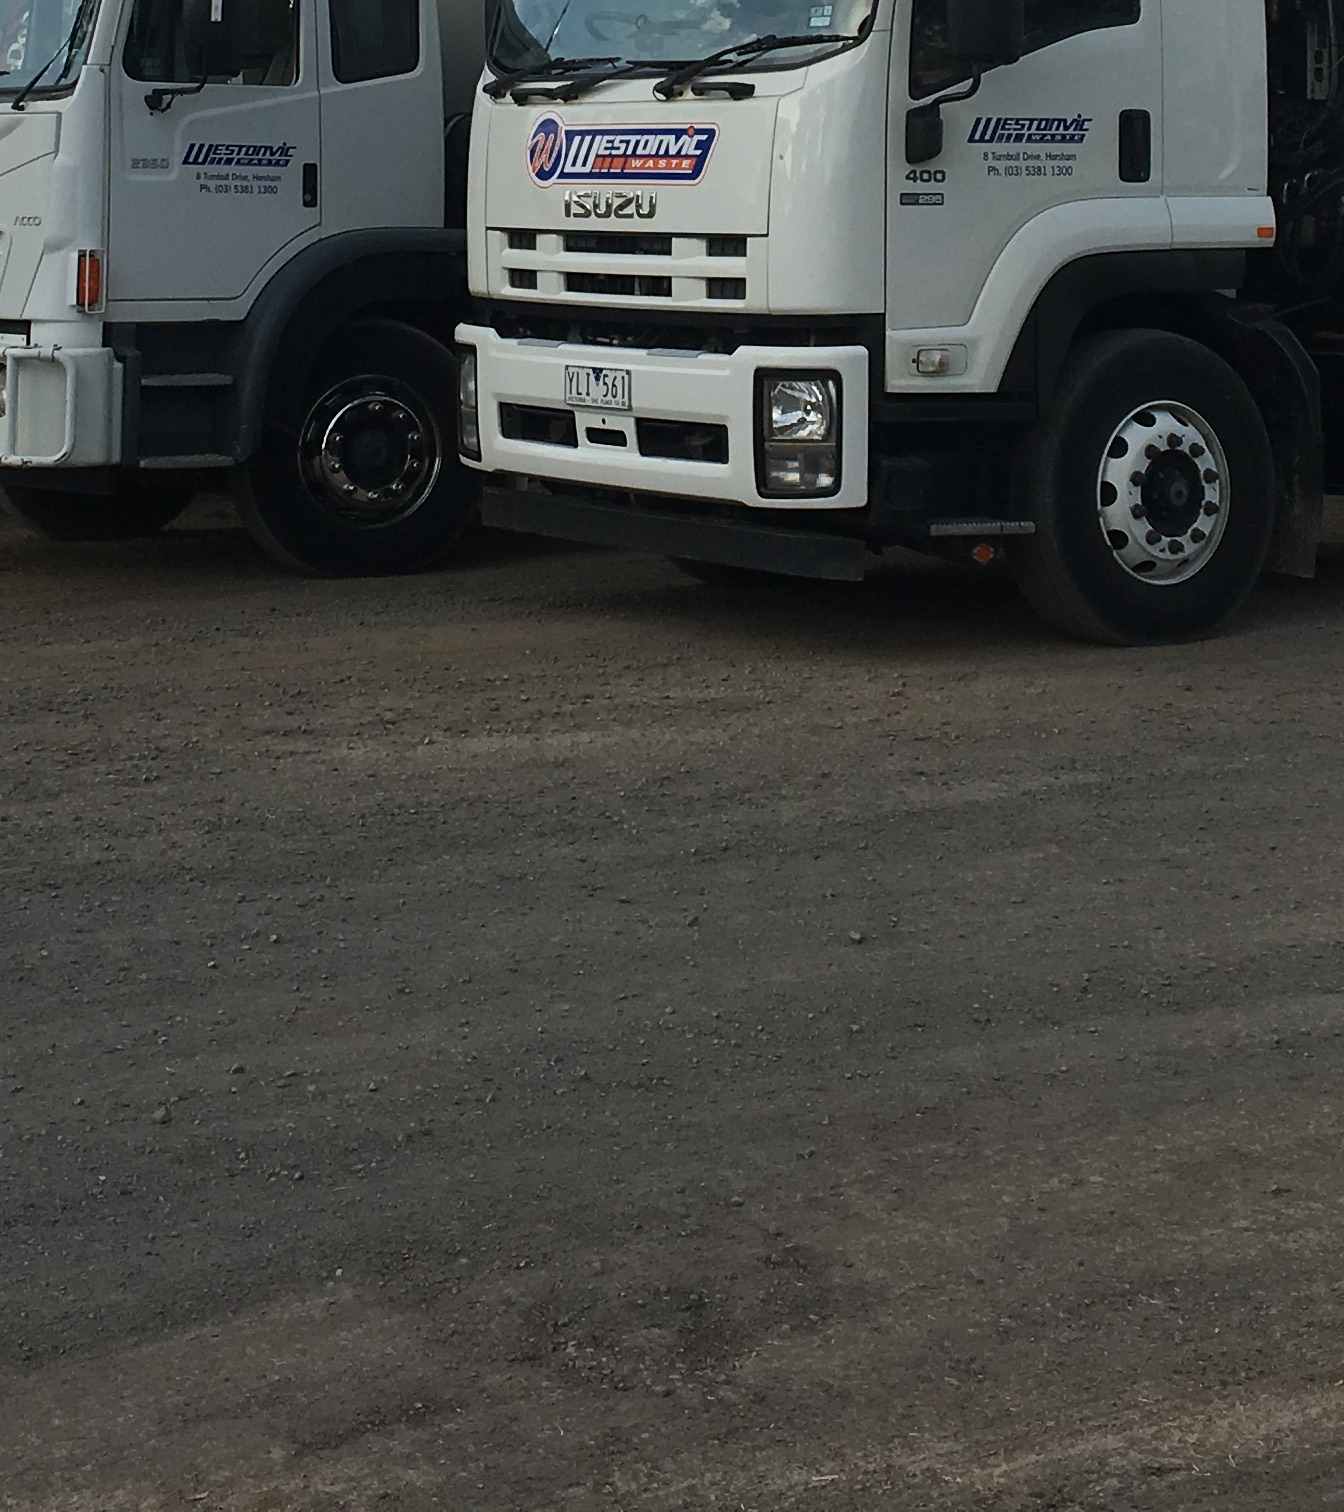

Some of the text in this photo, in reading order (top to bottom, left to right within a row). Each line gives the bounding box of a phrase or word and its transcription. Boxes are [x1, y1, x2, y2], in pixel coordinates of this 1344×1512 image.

[983, 152, 988, 161] 8
[631, 159, 691, 168] WASTE
[905, 169, 946, 183] 400
[987, 165, 1073, 177] Ph. (03) 5381 1300
[258, 185, 278, 194] 1300
[564, 190, 657, 219] ISUZU
[14, 215, 42, 227] ACCO
[567, 371, 625, 399] YLI 561
